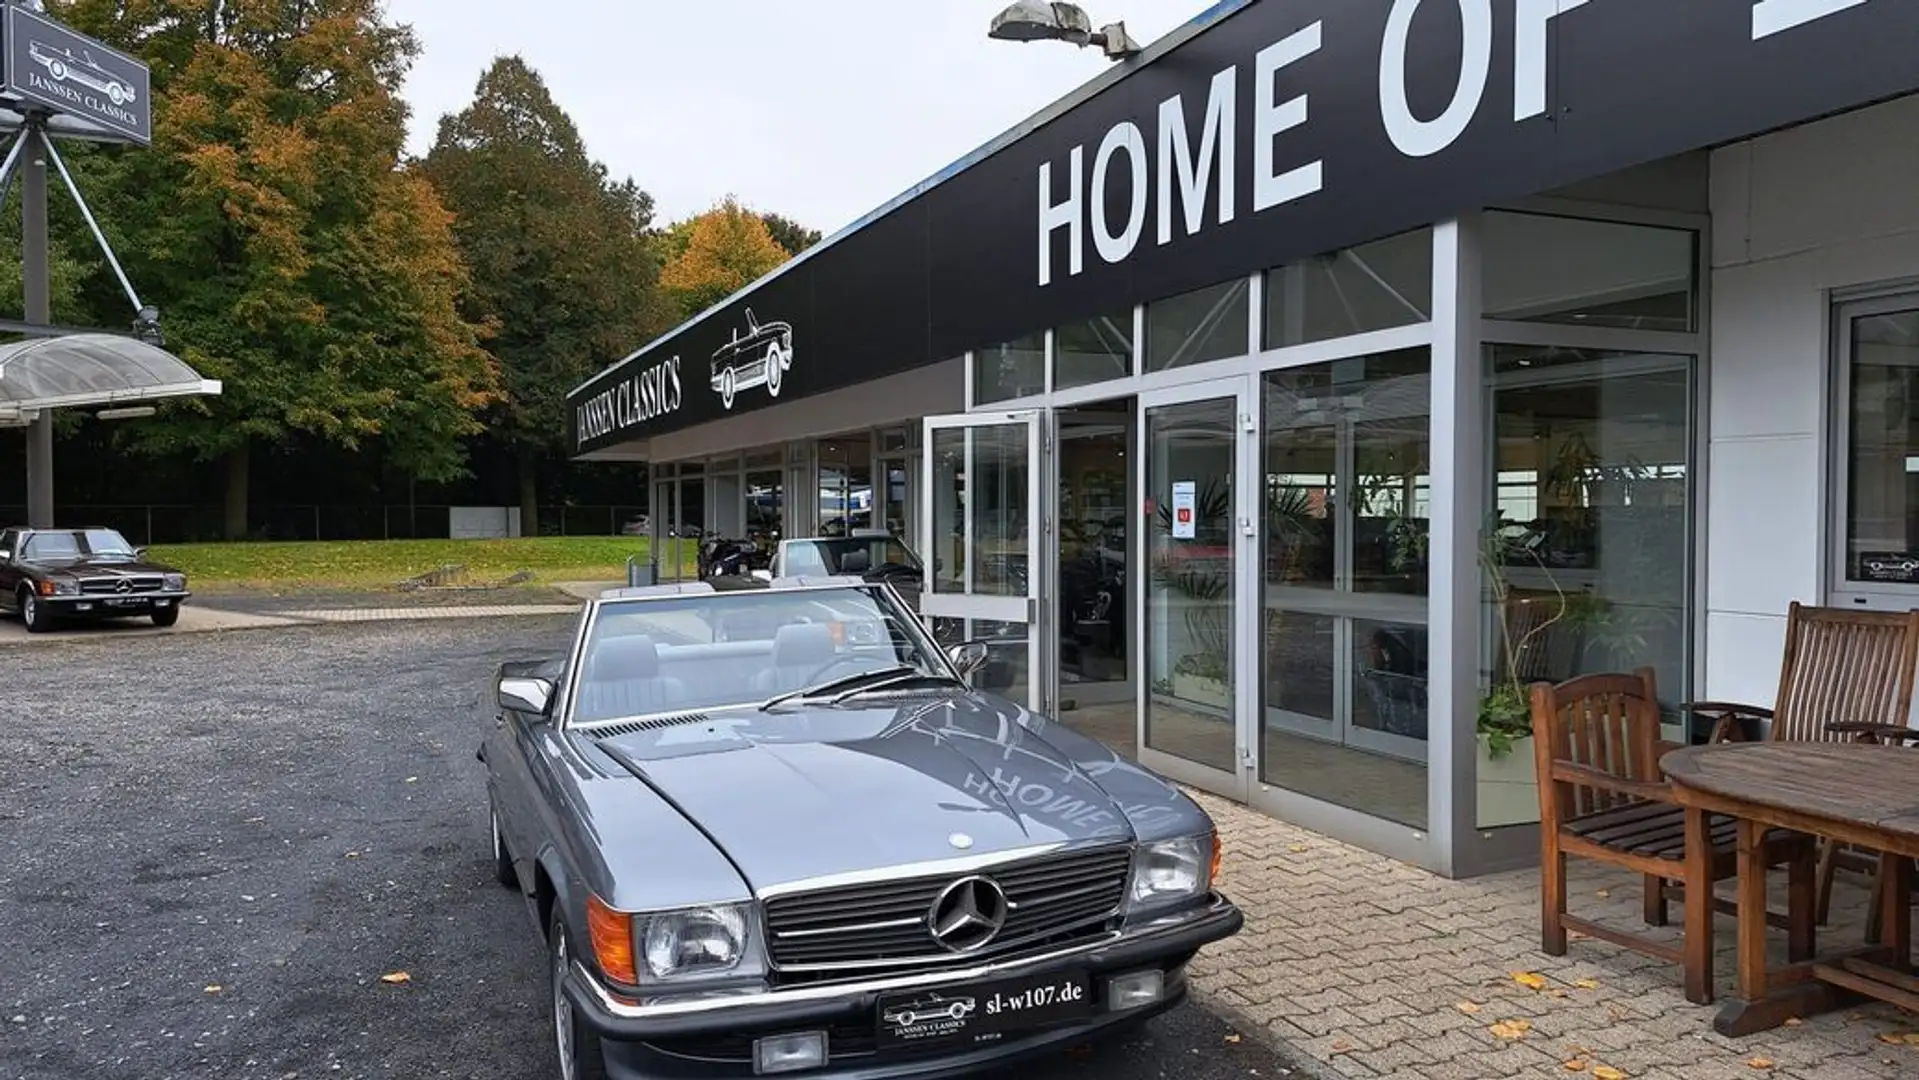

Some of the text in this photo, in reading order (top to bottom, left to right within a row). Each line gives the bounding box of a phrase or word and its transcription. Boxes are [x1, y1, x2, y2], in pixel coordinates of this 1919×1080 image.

[29, 72, 137, 126] JANSSEN CLASSICS
[1039, 21, 1322, 287] HOME
[577, 355, 682, 452] JANSSEN CLASSICS
[985, 981, 1084, 1016] sl-w107.de
